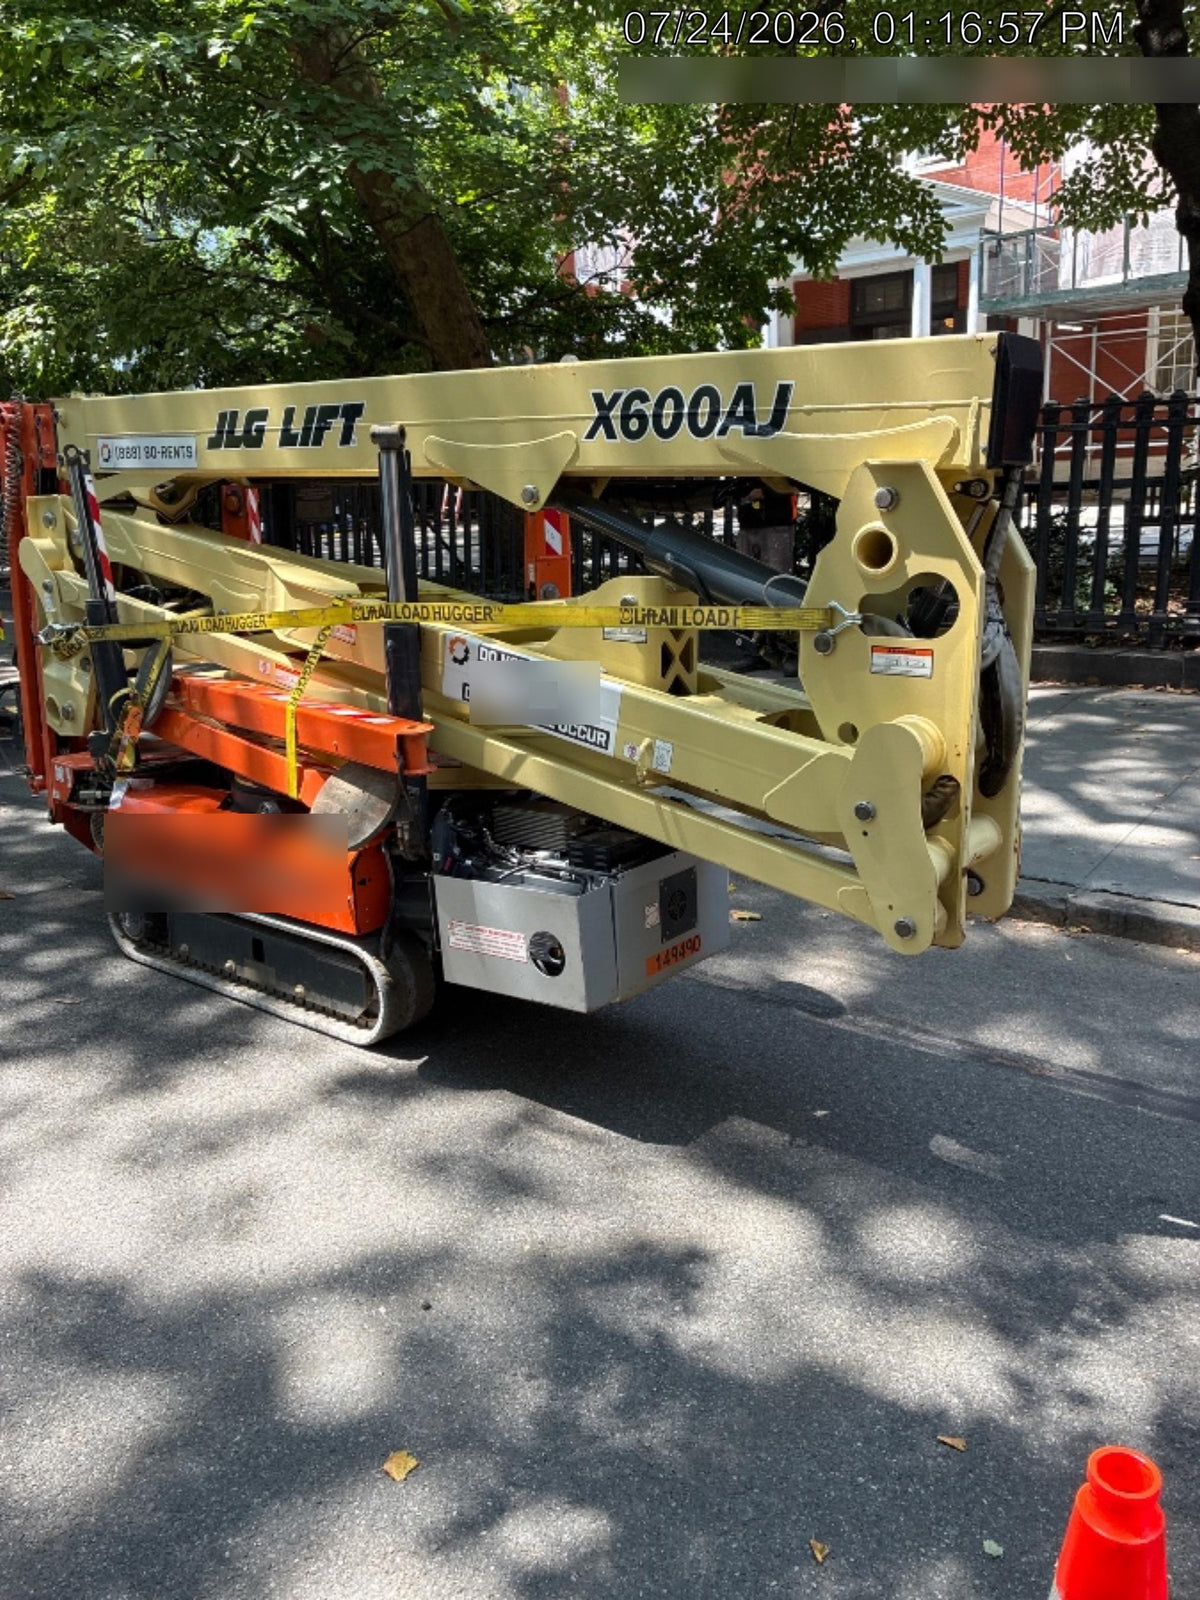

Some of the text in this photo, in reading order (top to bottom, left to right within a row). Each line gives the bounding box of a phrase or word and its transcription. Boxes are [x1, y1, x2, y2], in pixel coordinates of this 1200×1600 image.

[207, 402, 366, 449] JLG LIFT
[581, 381, 795, 442] X600AJ
[394, 604, 430, 620] LOAD
[682, 608, 728, 627] LOAD
[656, 935, 702, 970] 149490
